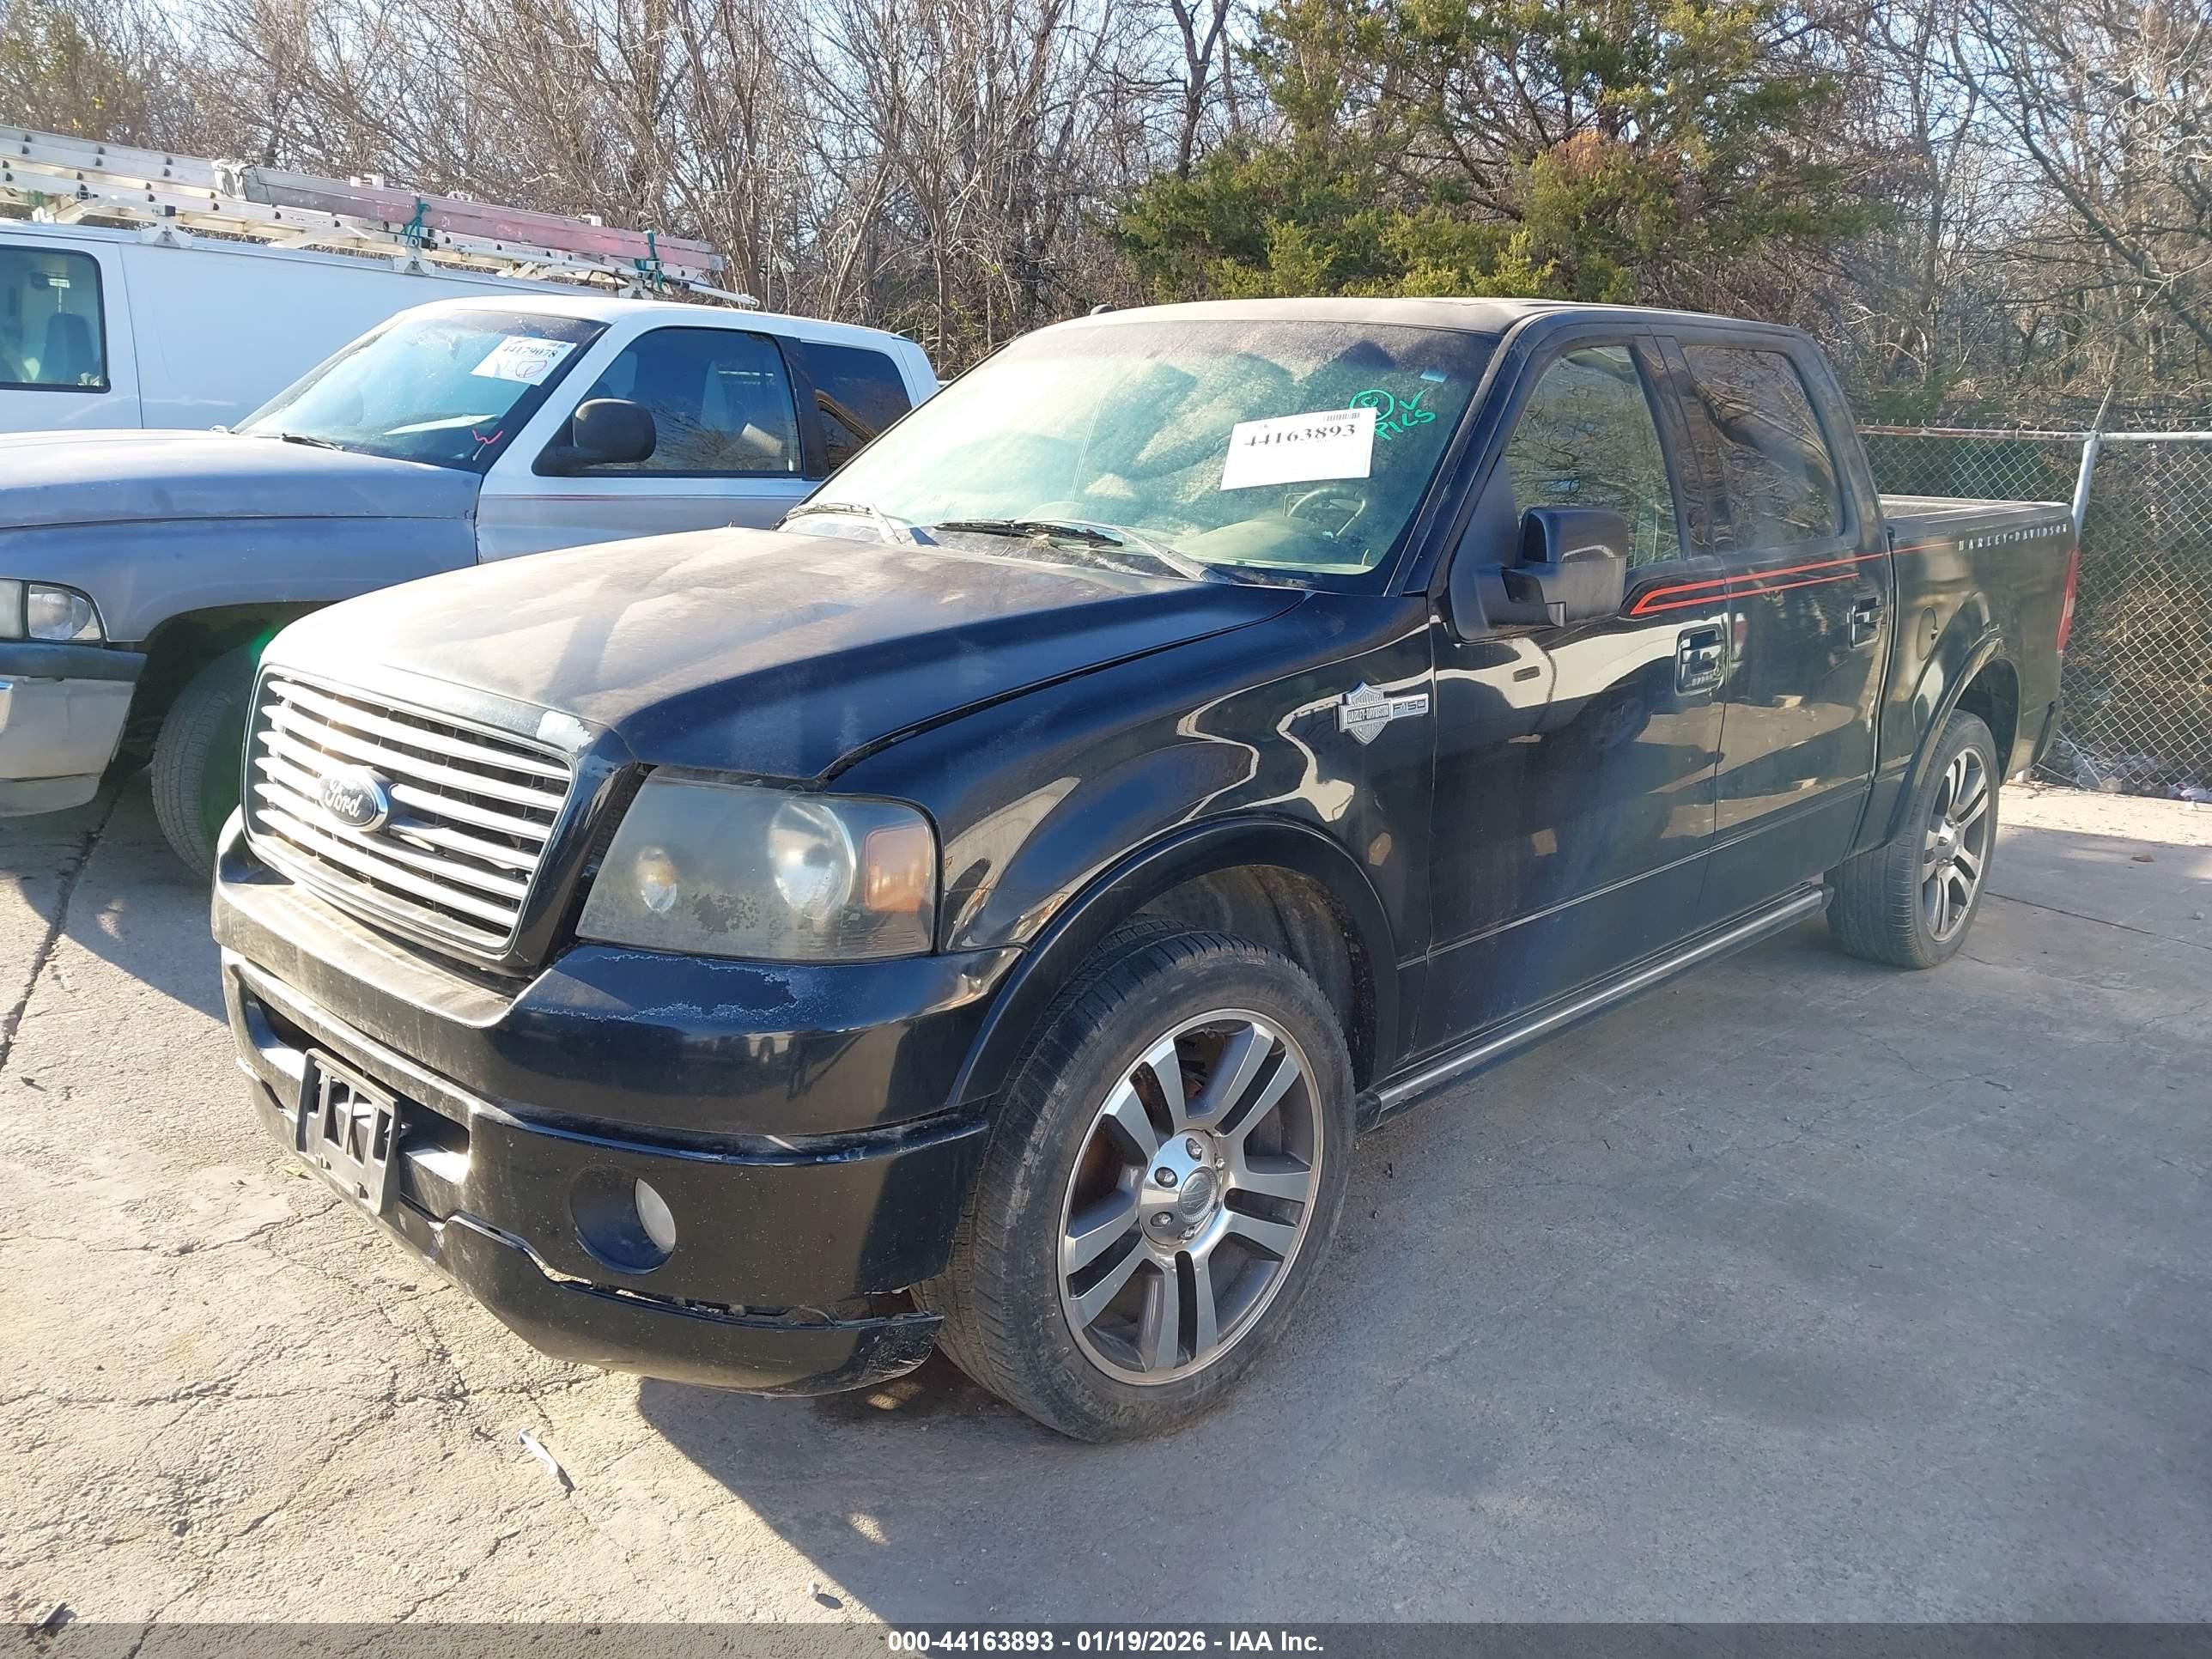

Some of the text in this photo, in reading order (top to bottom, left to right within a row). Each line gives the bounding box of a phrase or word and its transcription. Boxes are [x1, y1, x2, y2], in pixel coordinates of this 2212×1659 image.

[1244, 424, 1355, 447] 44163893
[1958, 523, 2068, 551] HARLEY-DAVIDSON
[325, 779, 362, 817] Ford
